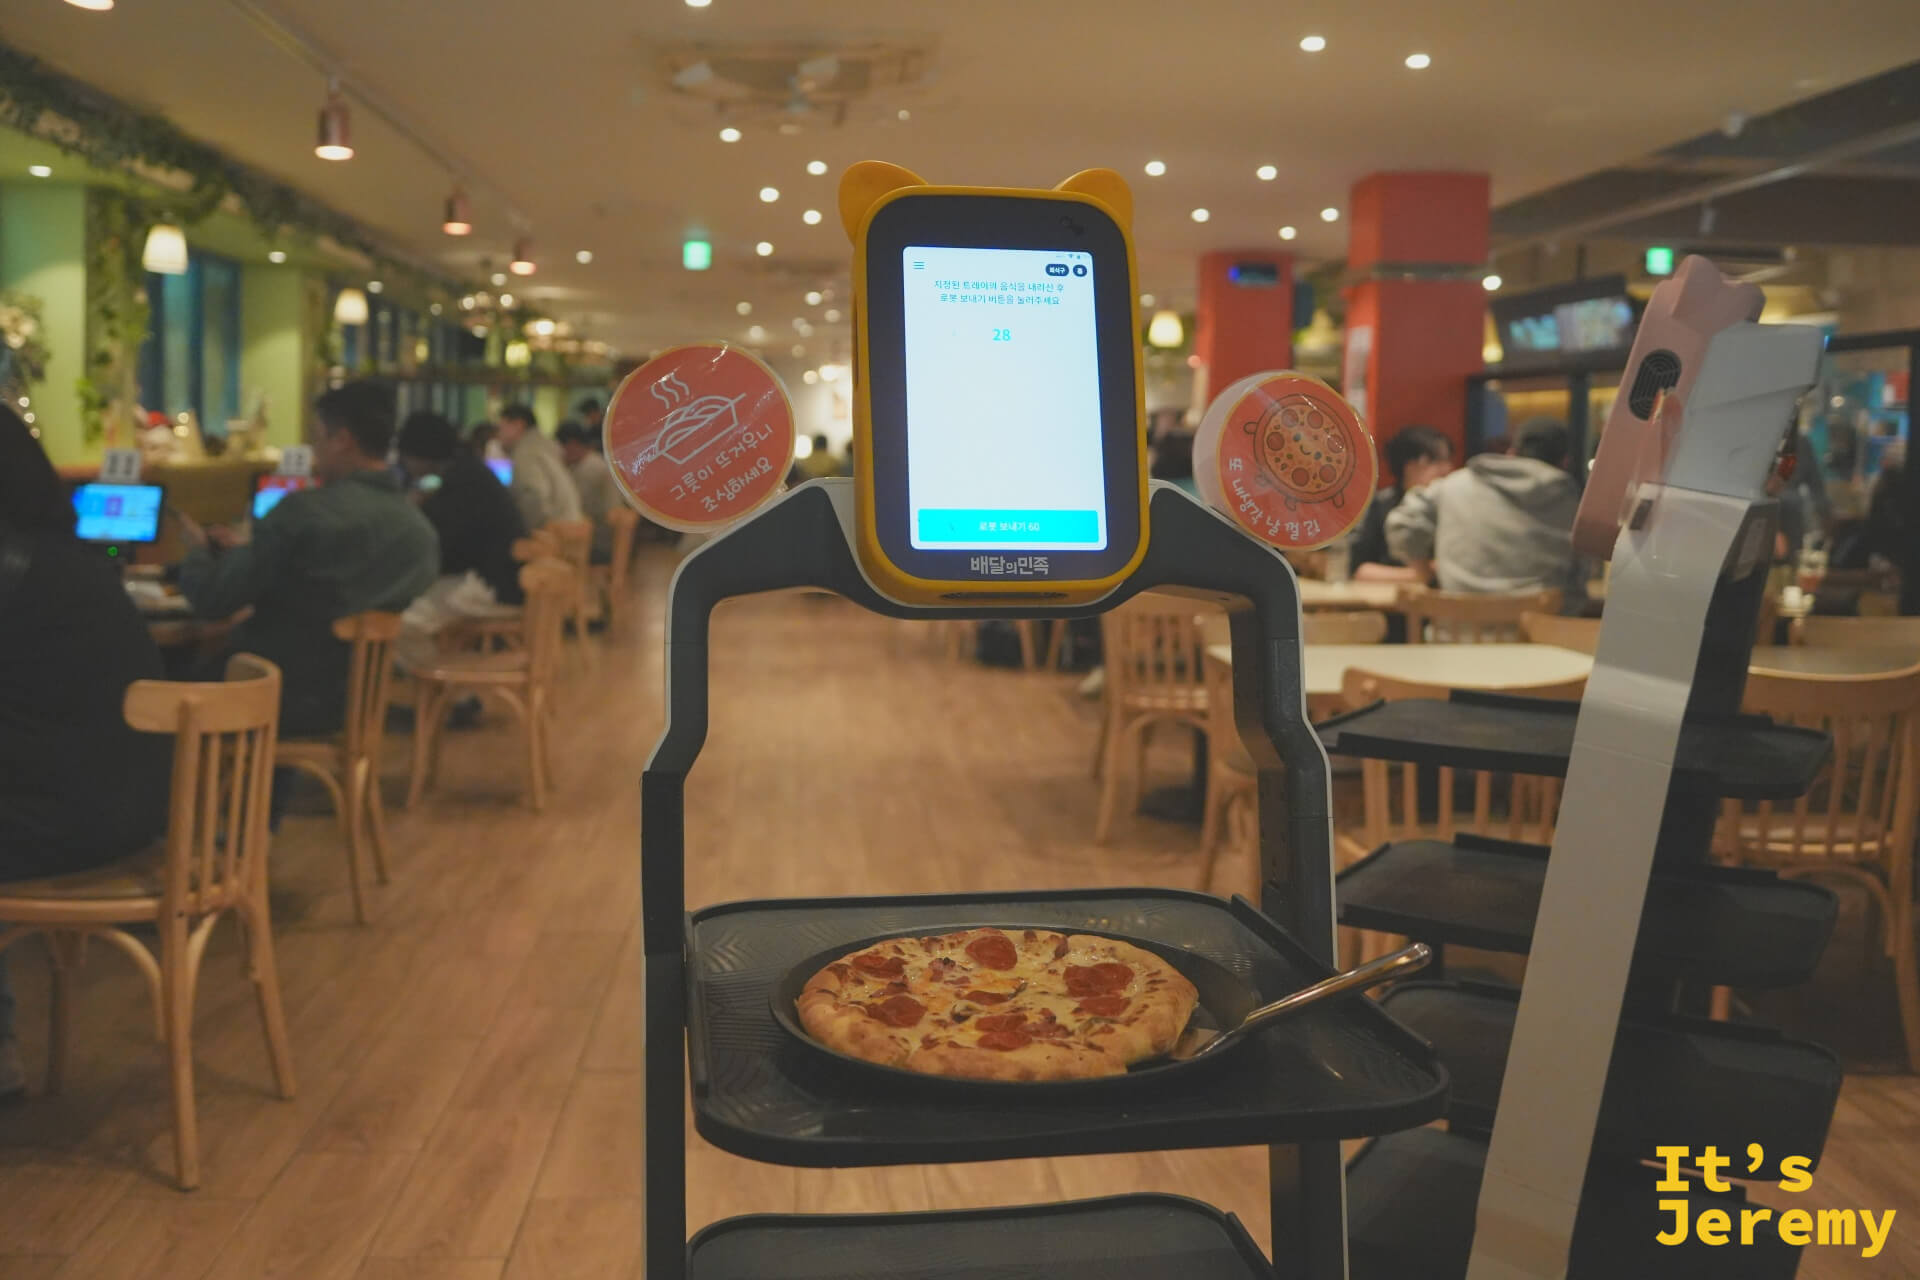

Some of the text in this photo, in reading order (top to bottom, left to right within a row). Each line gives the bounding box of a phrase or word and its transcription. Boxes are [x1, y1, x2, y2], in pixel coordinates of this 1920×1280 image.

[934, 280, 960, 290] 지정된
[1000, 282, 1025, 292] 음식을
[1028, 283, 1054, 292] 내리신
[940, 293, 1060, 305] 로봇 보내기 버튼을 눌러주세요
[992, 329, 1011, 341] 28
[670, 424, 773, 501] 그릇이 뜨거우니
[1229, 457, 1243, 472] 또
[701, 456, 773, 512] 조심하세요
[1000, 521, 1025, 532] 보내기
[970, 555, 1049, 575] 배달의민족
